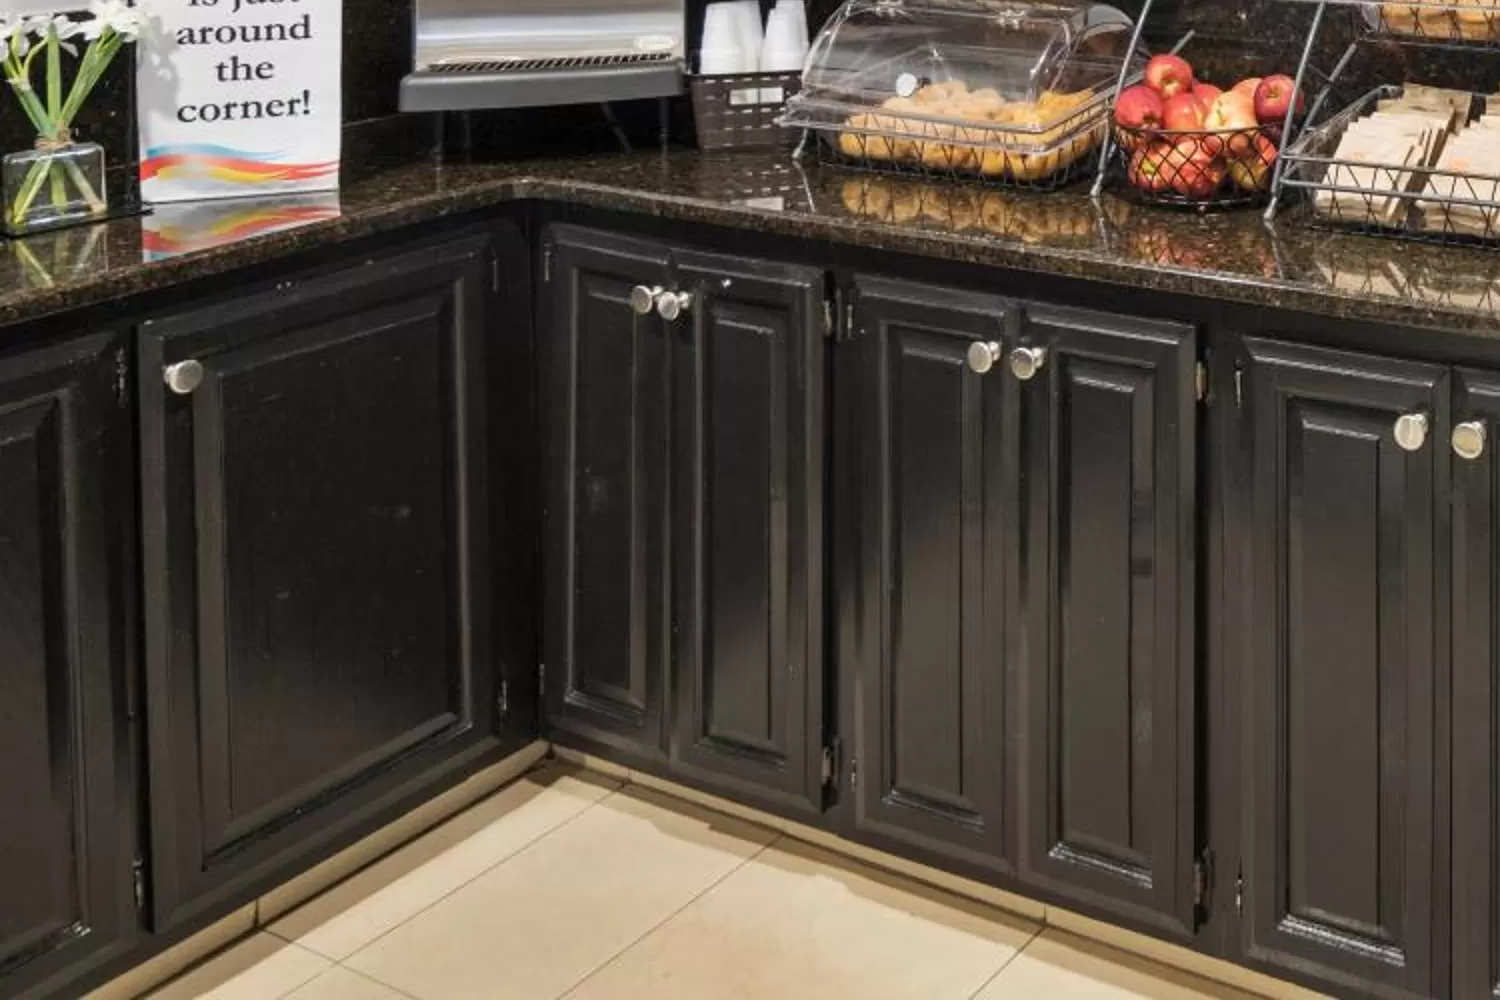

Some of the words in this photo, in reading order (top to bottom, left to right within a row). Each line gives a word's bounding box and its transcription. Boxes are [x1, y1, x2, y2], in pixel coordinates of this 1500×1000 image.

[176, 14, 313, 46] around
[216, 56, 275, 82] the
[176, 90, 311, 124] corner!
